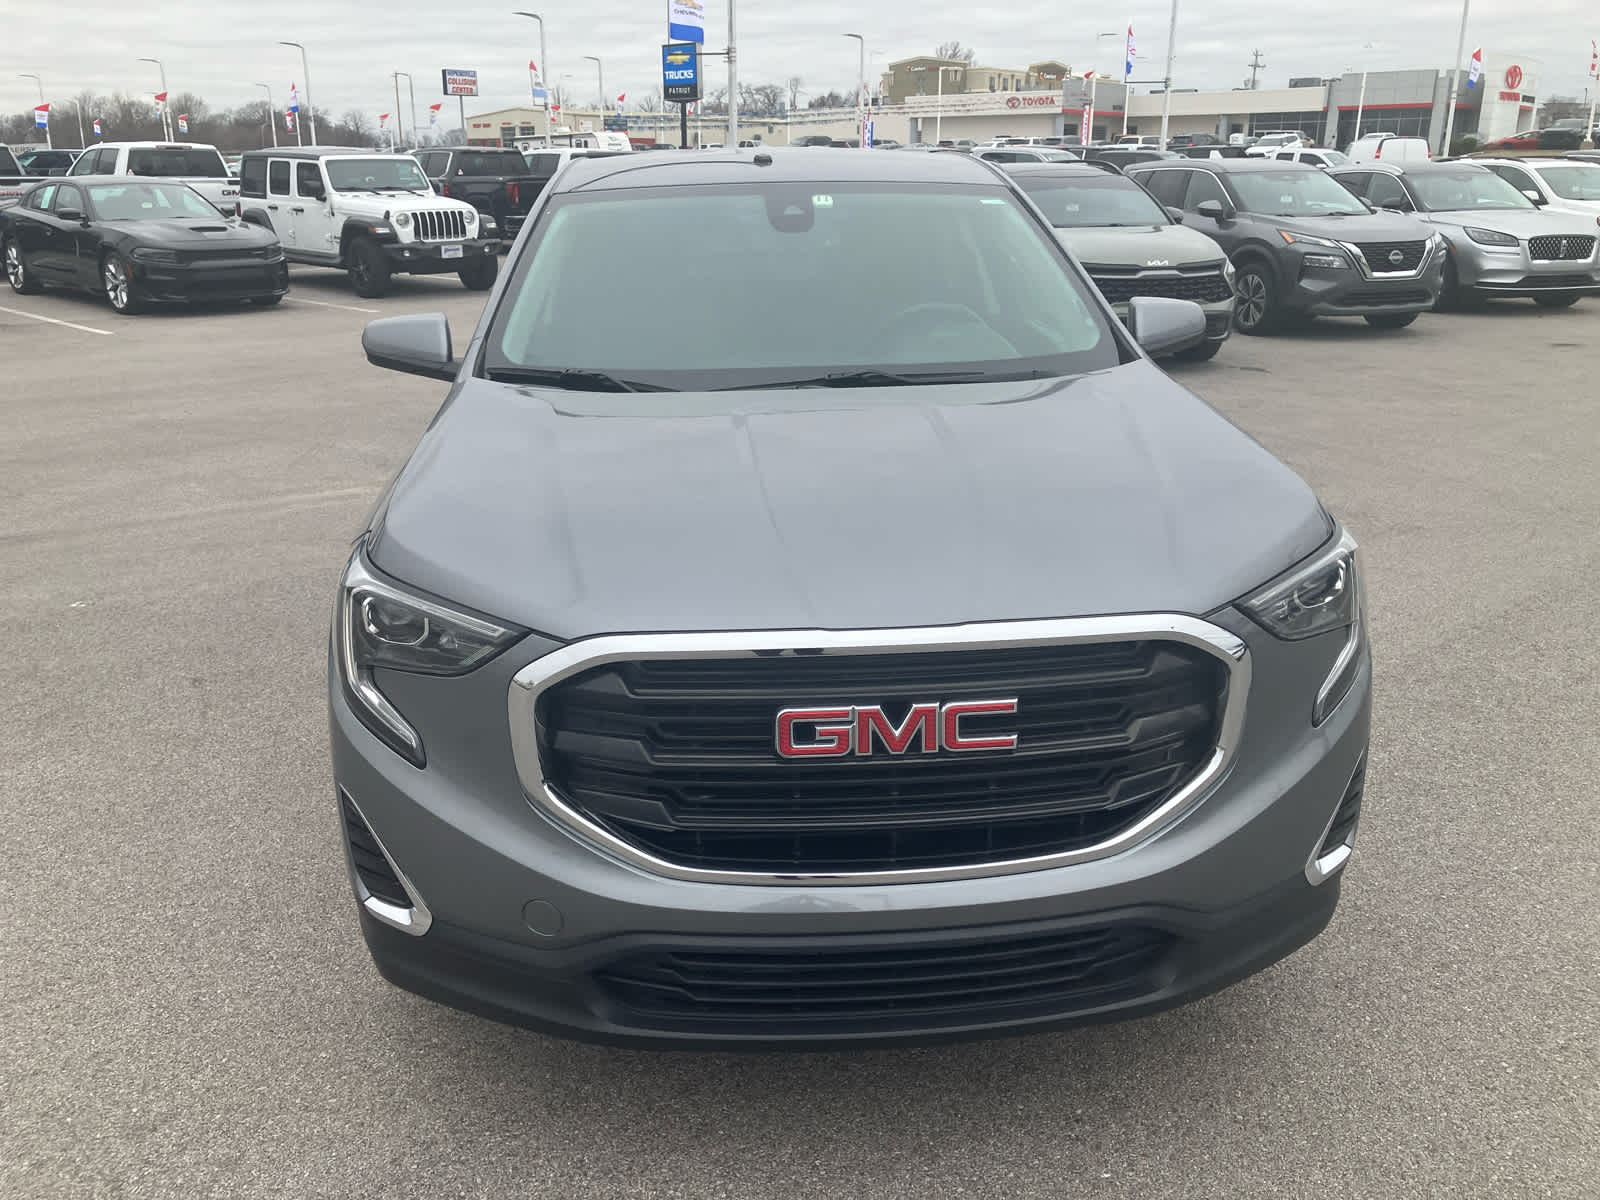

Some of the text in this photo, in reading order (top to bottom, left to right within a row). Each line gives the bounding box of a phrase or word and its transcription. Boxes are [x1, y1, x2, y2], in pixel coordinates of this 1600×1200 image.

[665, 70, 694, 80] TRUCKS
[451, 86, 473, 95] CENTER
[1022, 96, 1055, 106] TOYOTA
[776, 698, 1018, 758] GMC
